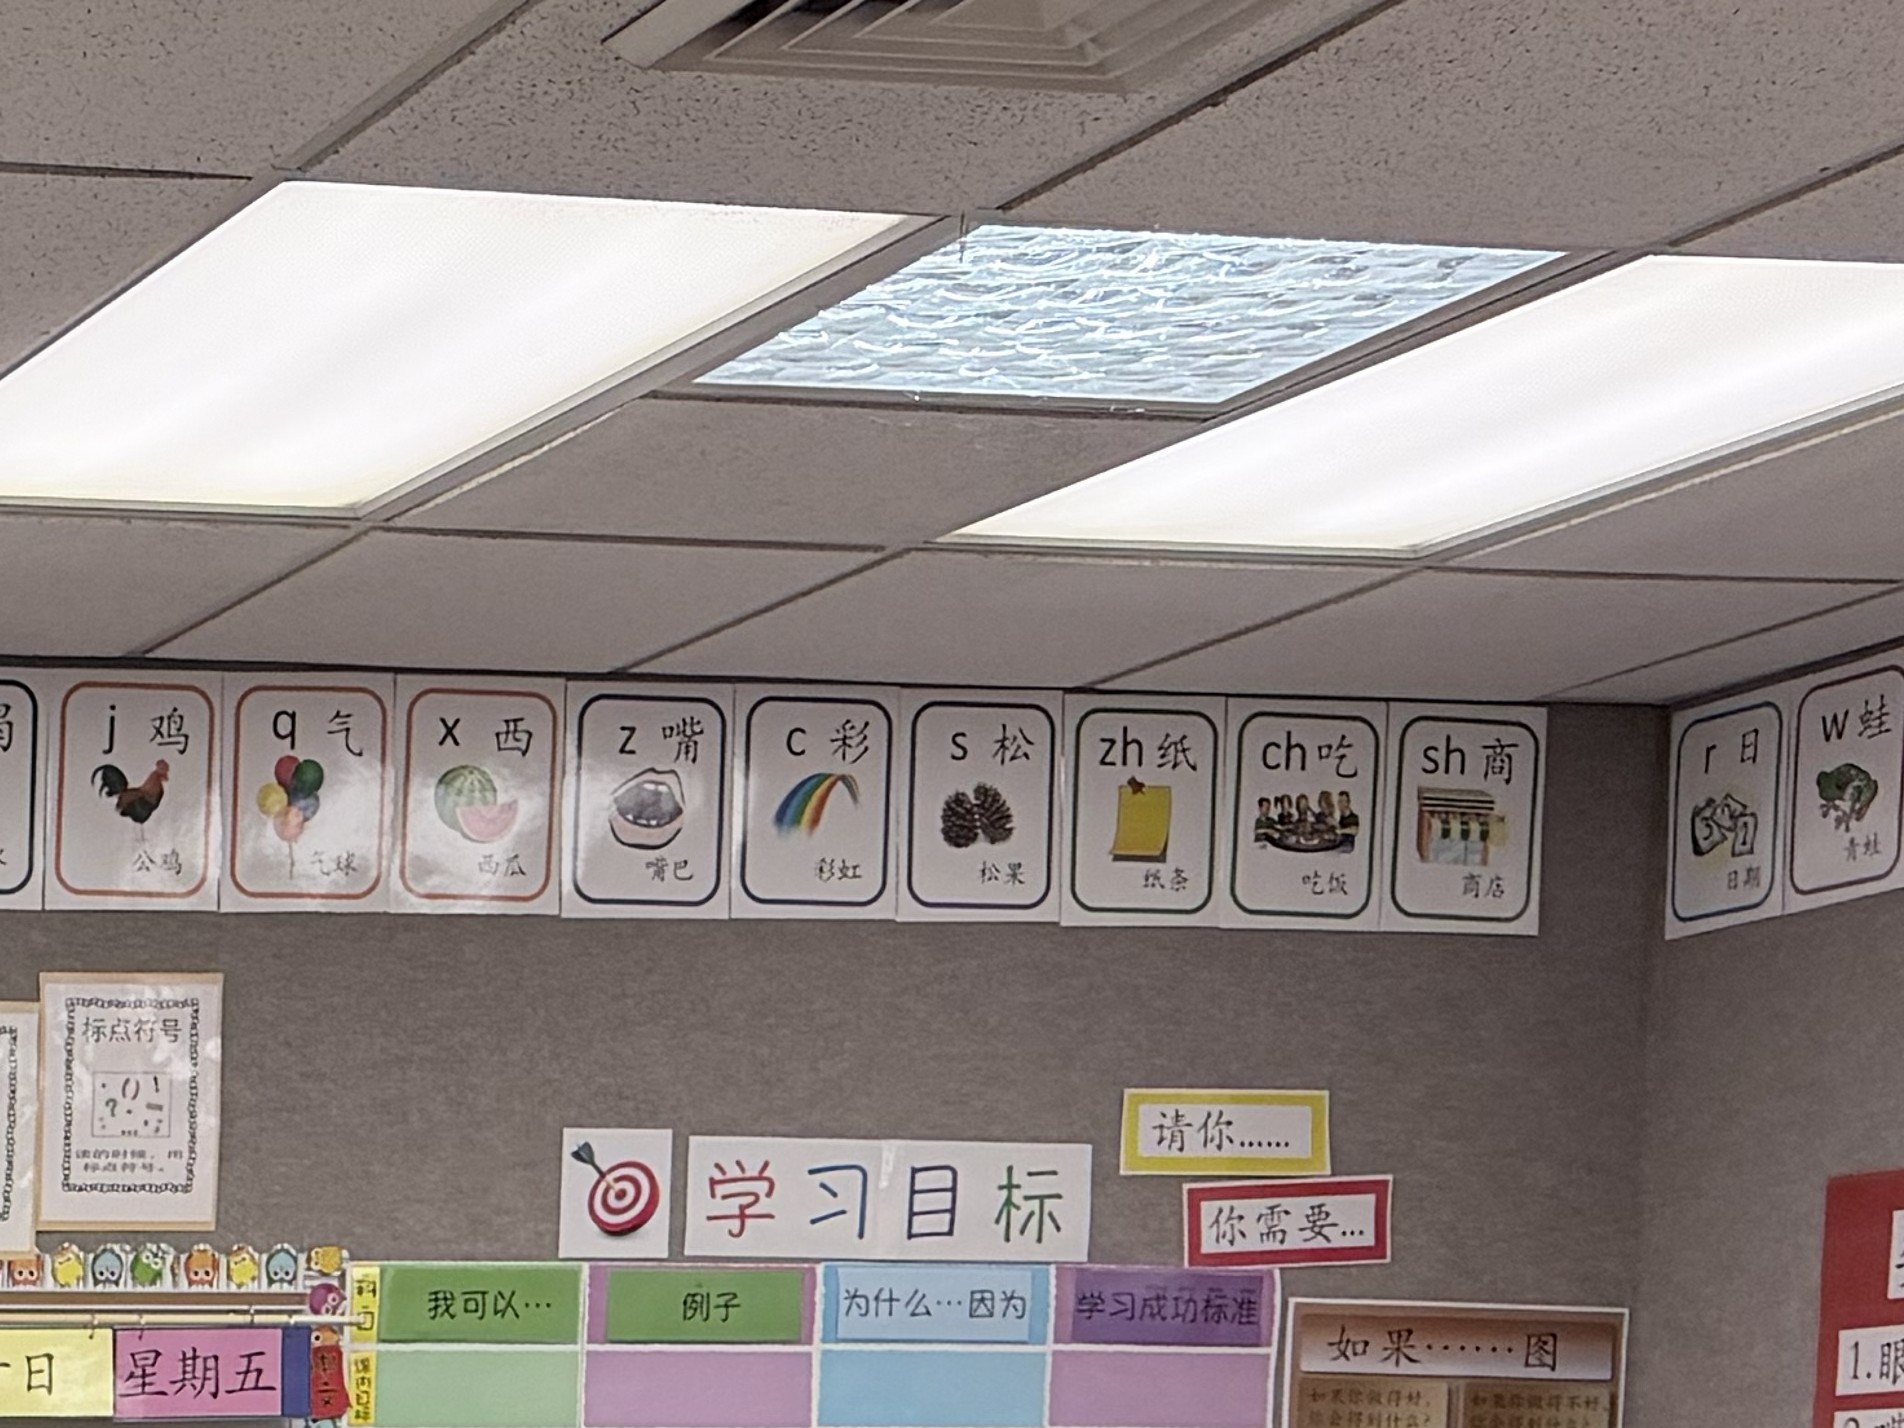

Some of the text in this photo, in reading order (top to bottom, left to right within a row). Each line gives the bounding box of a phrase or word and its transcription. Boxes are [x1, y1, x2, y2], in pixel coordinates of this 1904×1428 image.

[101, 704, 190, 755] j 鸡
[272, 709, 365, 757] q 气
[438, 716, 534, 756] x 西
[1821, 693, 1892, 743] w 蛙
[618, 716, 705, 764] z 嘴
[786, 718, 872, 764] c 彩
[950, 723, 1035, 767] s 松
[1098, 726, 1198, 773] zh 纸
[1260, 730, 1359, 779] ch 吃
[1421, 733, 1519, 786] sh 商
[1703, 728, 1760, 774] r 日
[131, 849, 184, 877] 公鸡
[309, 851, 358, 876] 气球
[478, 854, 526, 877] 西瓜
[644, 855, 695, 883] 嘴巴
[813, 858, 864, 883] 彩虹
[979, 861, 1026, 885] 松果
[1142, 868, 1190, 893] 纸条
[1301, 872, 1348, 897] 吃饭
[1461, 873, 1505, 899] 商店
[82, 1016, 183, 1044] 标点符号
[704, 1157, 1062, 1246] 学习目标
[680, 1289, 743, 1324] 例子
[1076, 1288, 1262, 1328] 学习成功标准
[118, 1345, 278, 1400] 星期五
